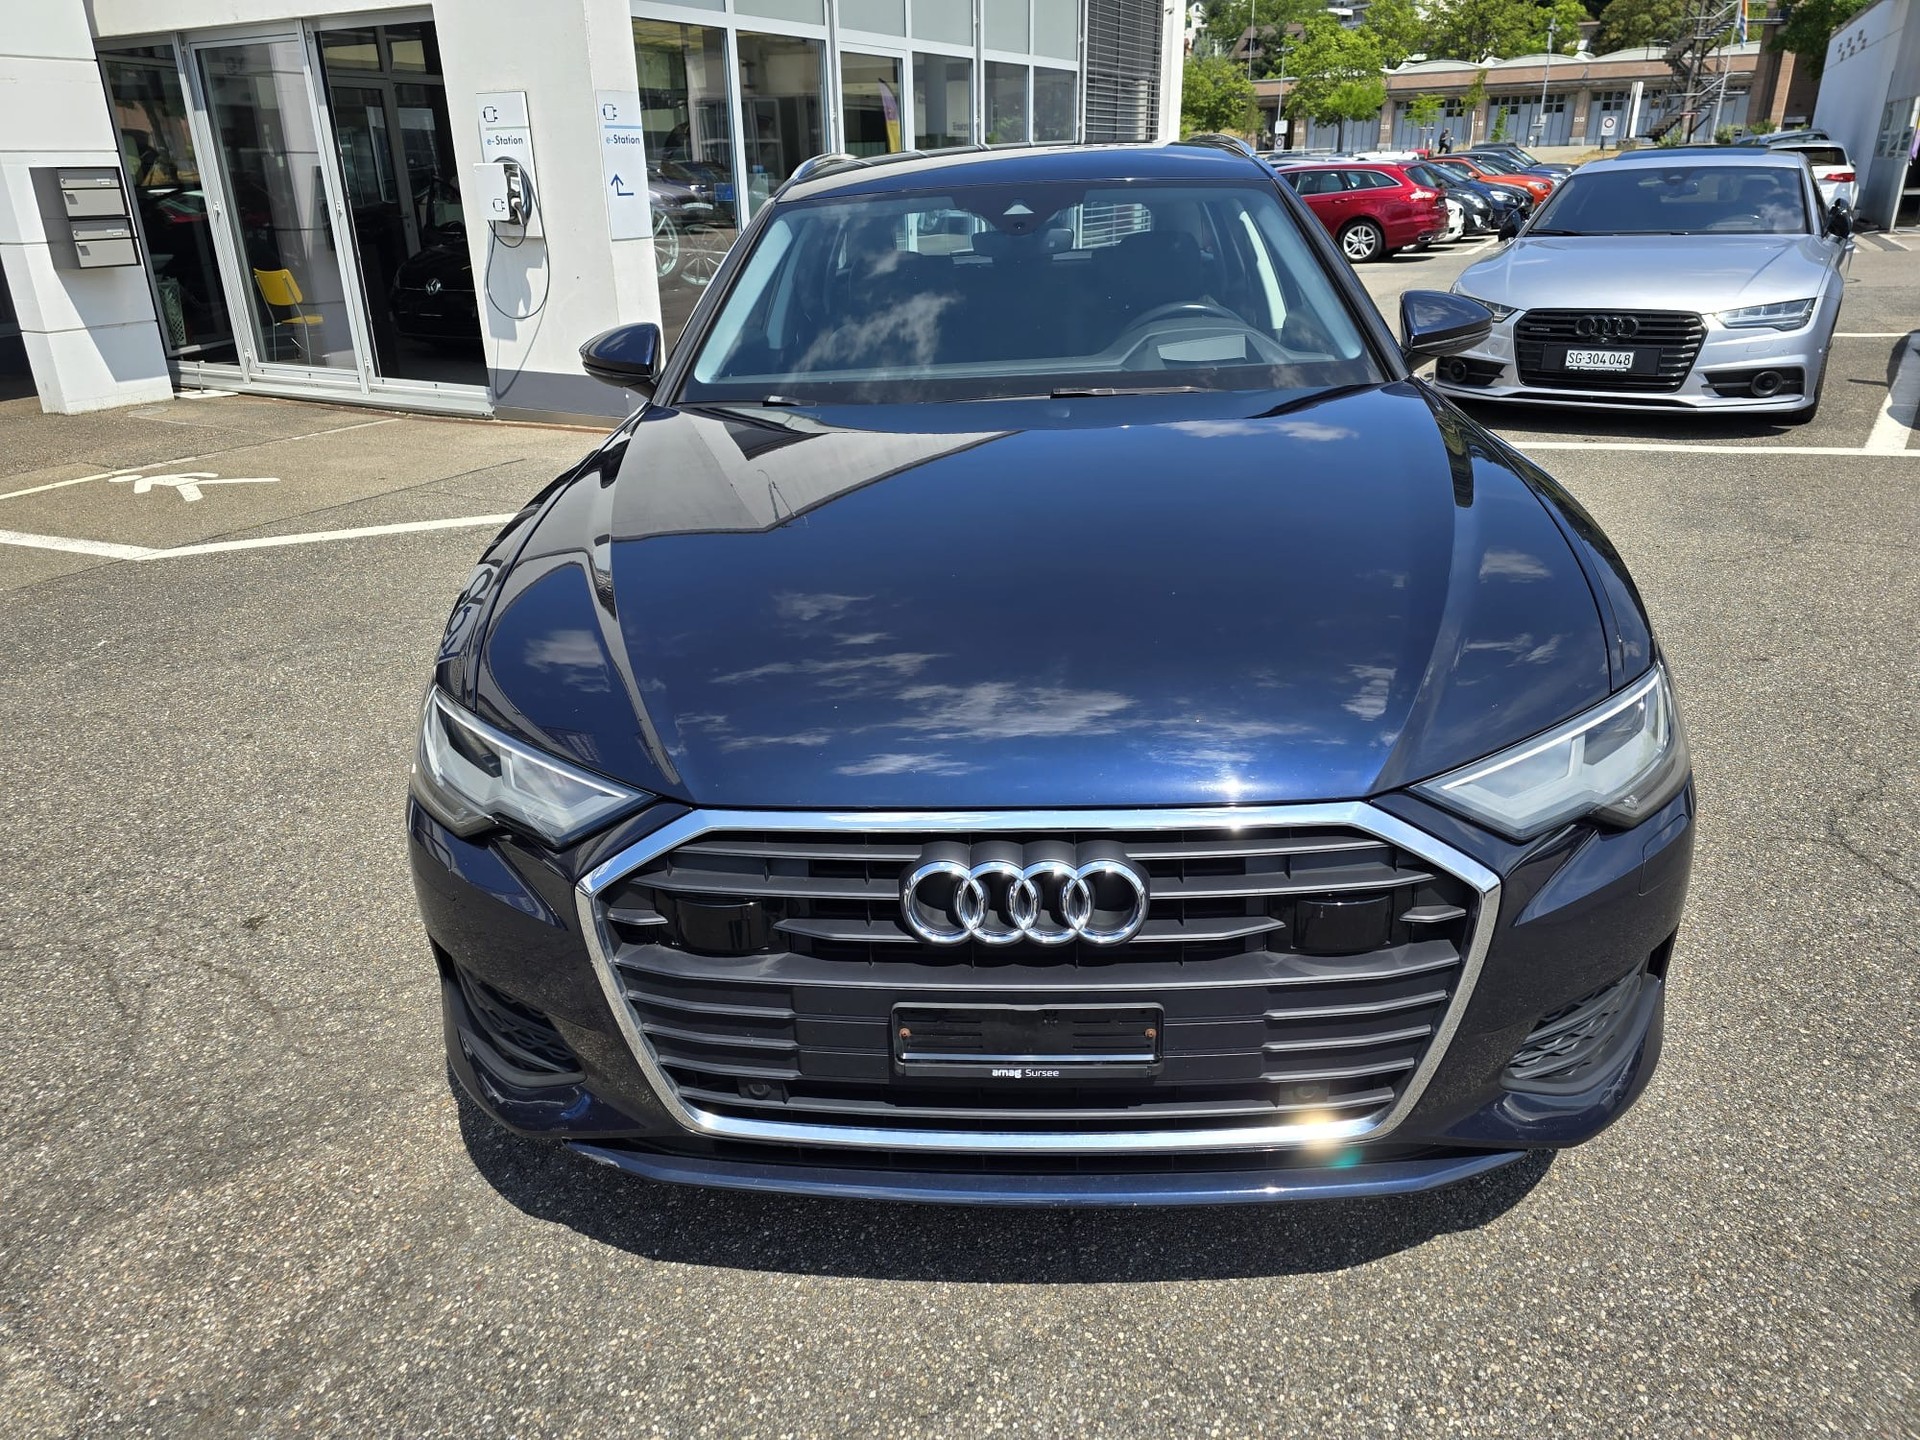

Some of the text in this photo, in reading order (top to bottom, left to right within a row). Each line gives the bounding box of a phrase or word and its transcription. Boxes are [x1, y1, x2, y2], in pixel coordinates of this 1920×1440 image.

[486, 135, 523, 146] e-Station
[605, 134, 640, 145] e-Station
[1025, 1069, 1059, 1077] Sursee
